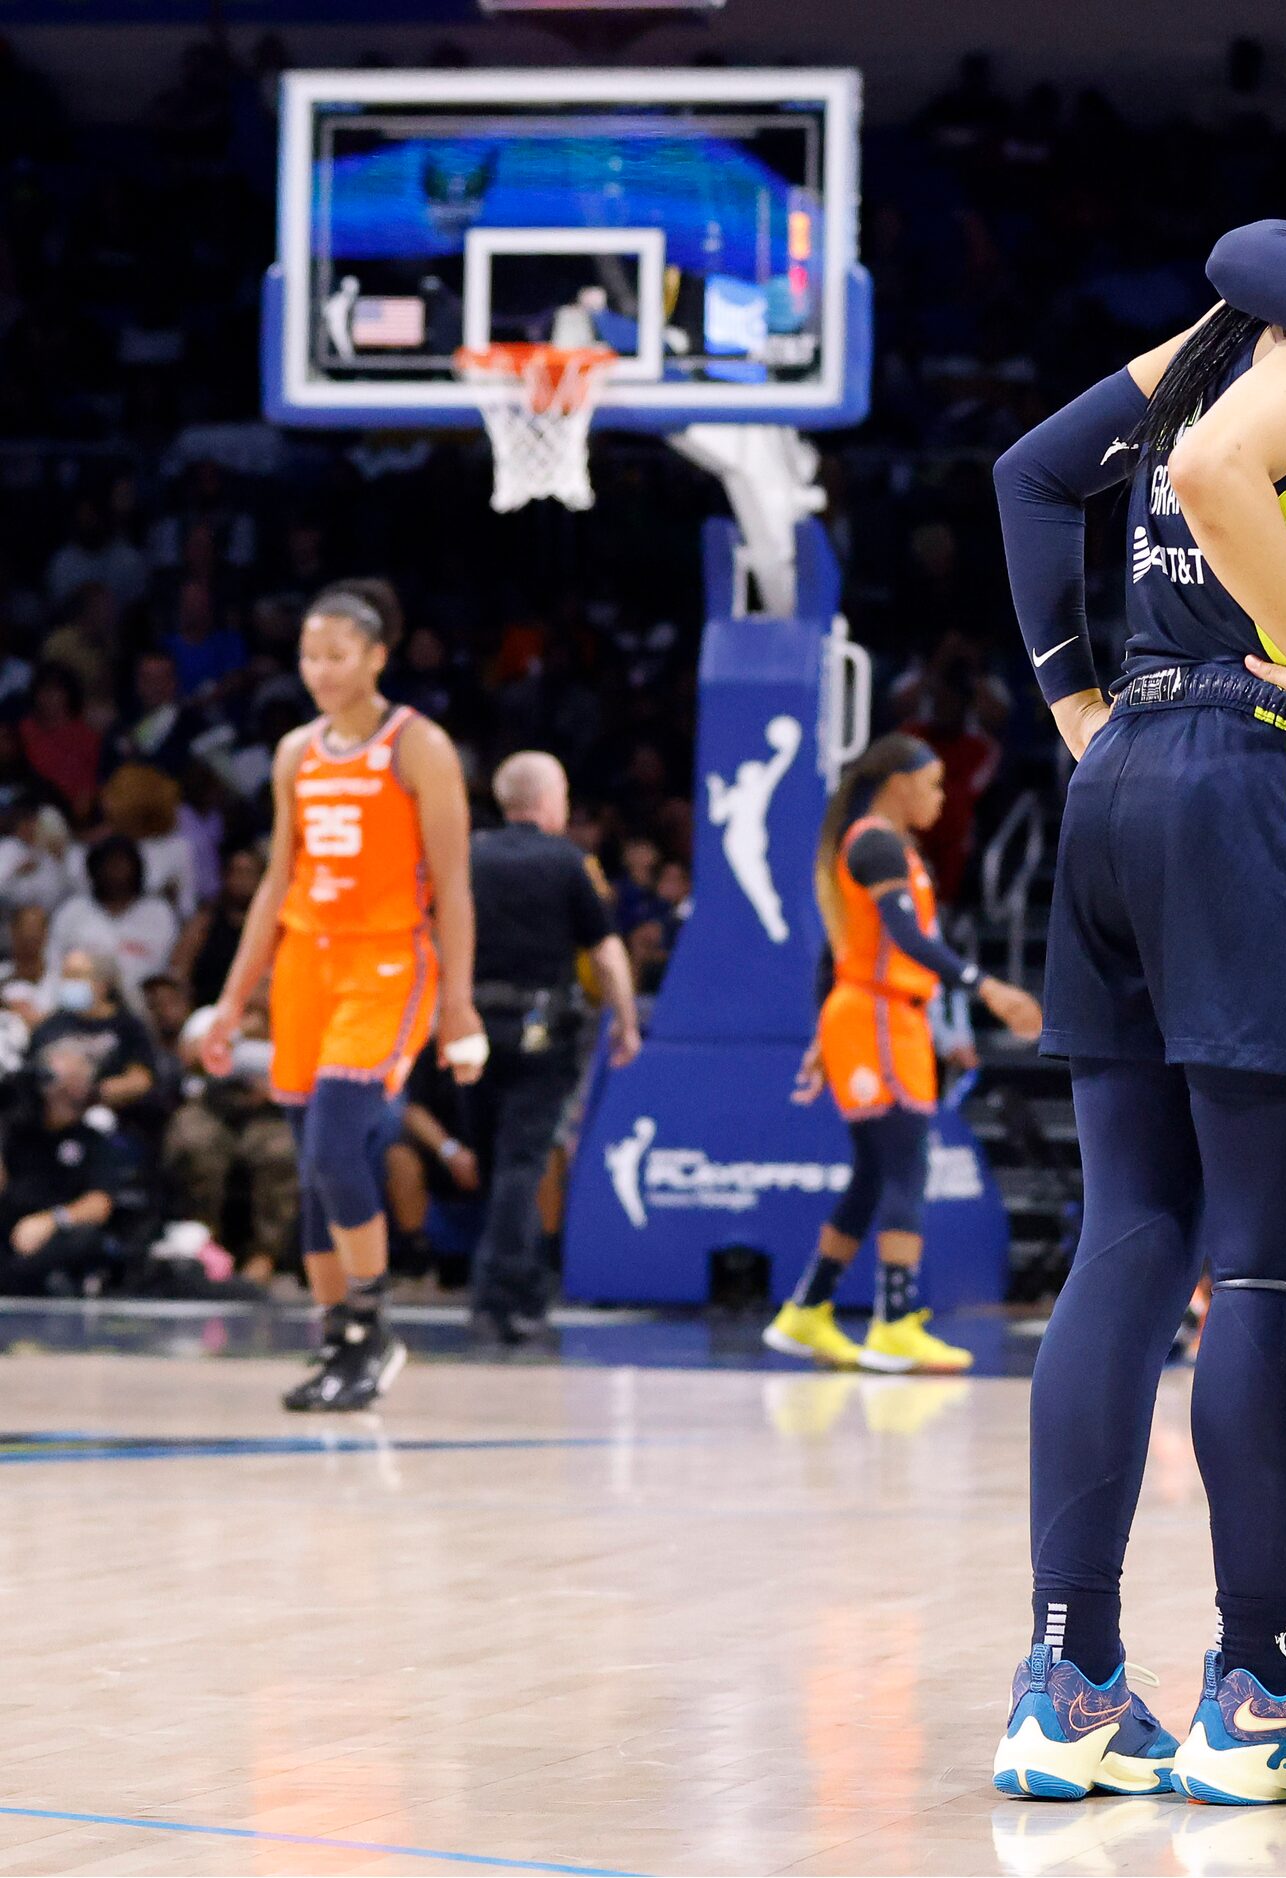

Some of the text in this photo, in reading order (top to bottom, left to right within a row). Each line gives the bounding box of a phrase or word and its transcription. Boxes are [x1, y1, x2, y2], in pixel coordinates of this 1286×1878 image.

[1149, 464, 1180, 516] GRA
[1150, 544, 1205, 585] AT&T
[303, 804, 363, 858] 25
